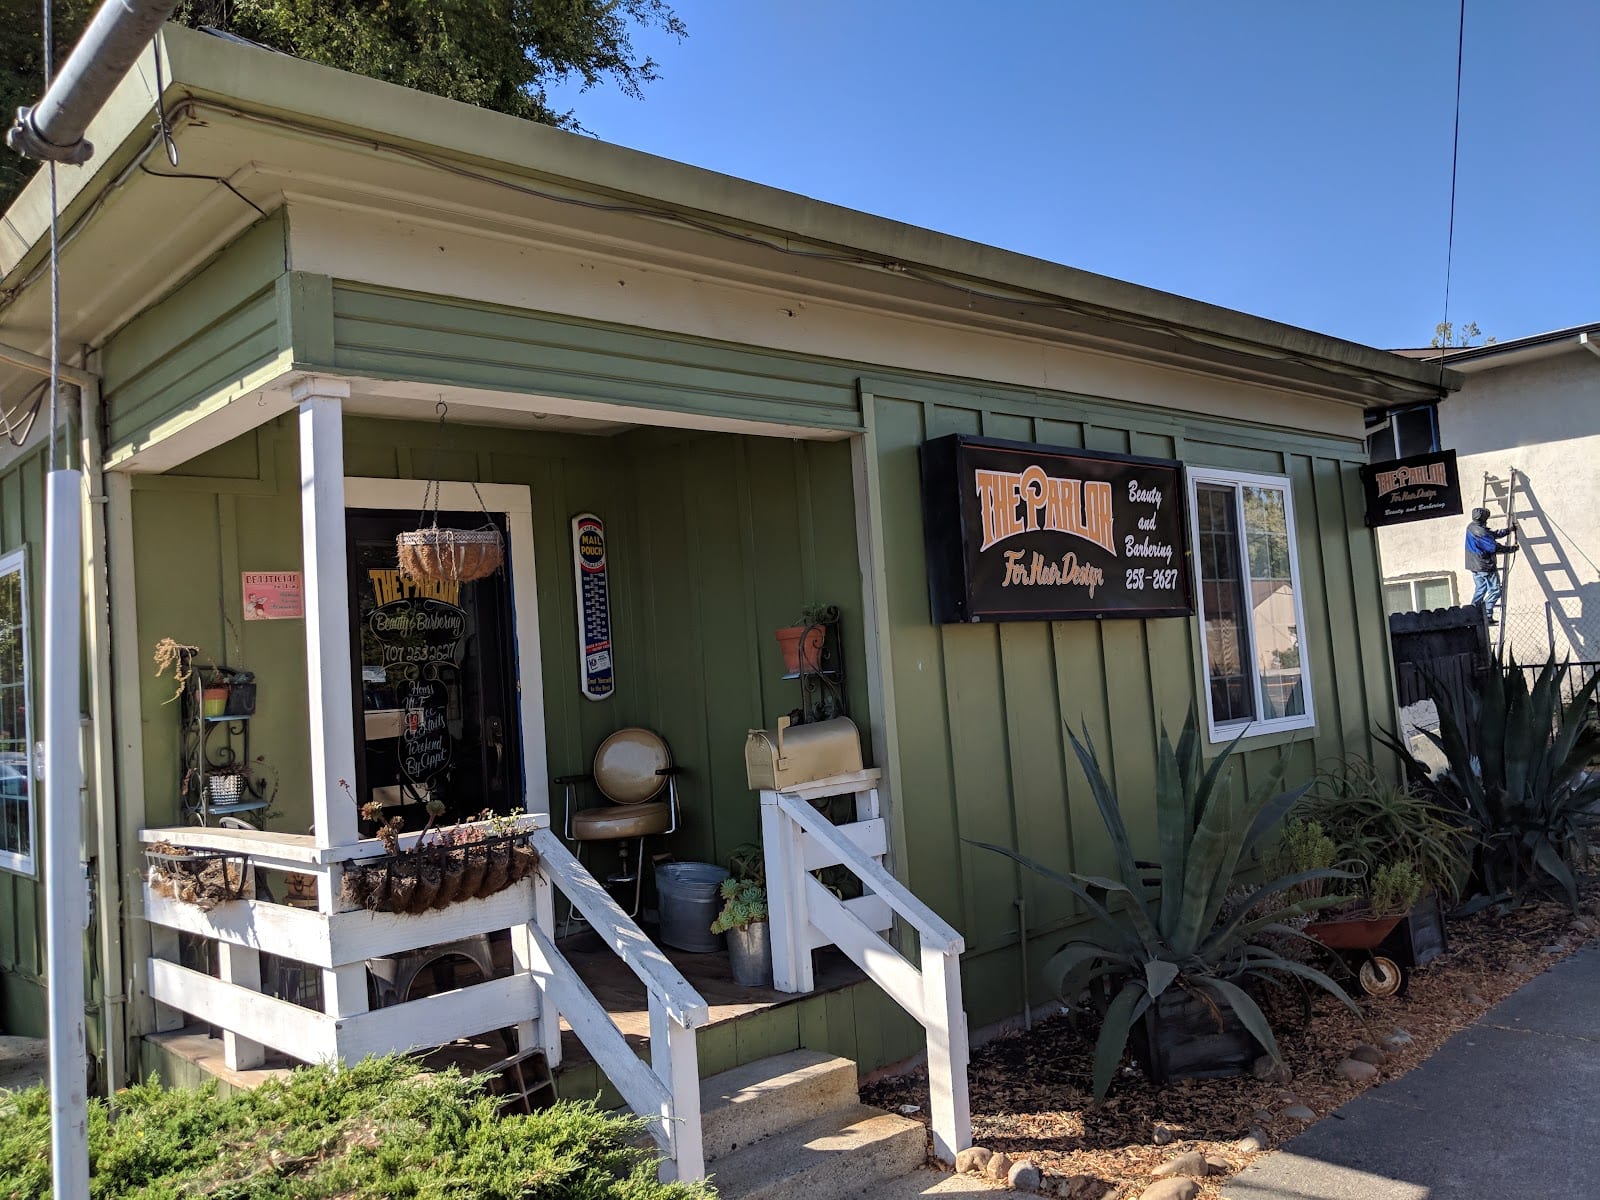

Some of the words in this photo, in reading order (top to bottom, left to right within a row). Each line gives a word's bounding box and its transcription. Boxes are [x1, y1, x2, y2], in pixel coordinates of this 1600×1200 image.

[1376, 470, 1400, 498] THE
[1397, 462, 1448, 487] PARLOR
[1128, 479, 1163, 510] Beauty
[975, 469, 1026, 552] THE
[1021, 465, 1117, 557] PARLOR
[1138, 511, 1157, 531] and
[581, 545, 603, 556] POUCH
[582, 535, 602, 545] MAIL
[1125, 534, 1173, 566] Barbering
[1002, 549, 1029, 587] For
[1030, 550, 1061, 586] Hair
[1061, 551, 1104, 599] Design
[368, 568, 403, 608] THE
[376, 612, 409, 638] Beauty
[417, 612, 461, 636] Barbering
[383, 644, 404, 662] 707
[429, 642, 456, 661] 2627
[409, 681, 434, 696] Hours
[406, 734, 442, 756] Weekend
[406, 757, 420, 777] By
